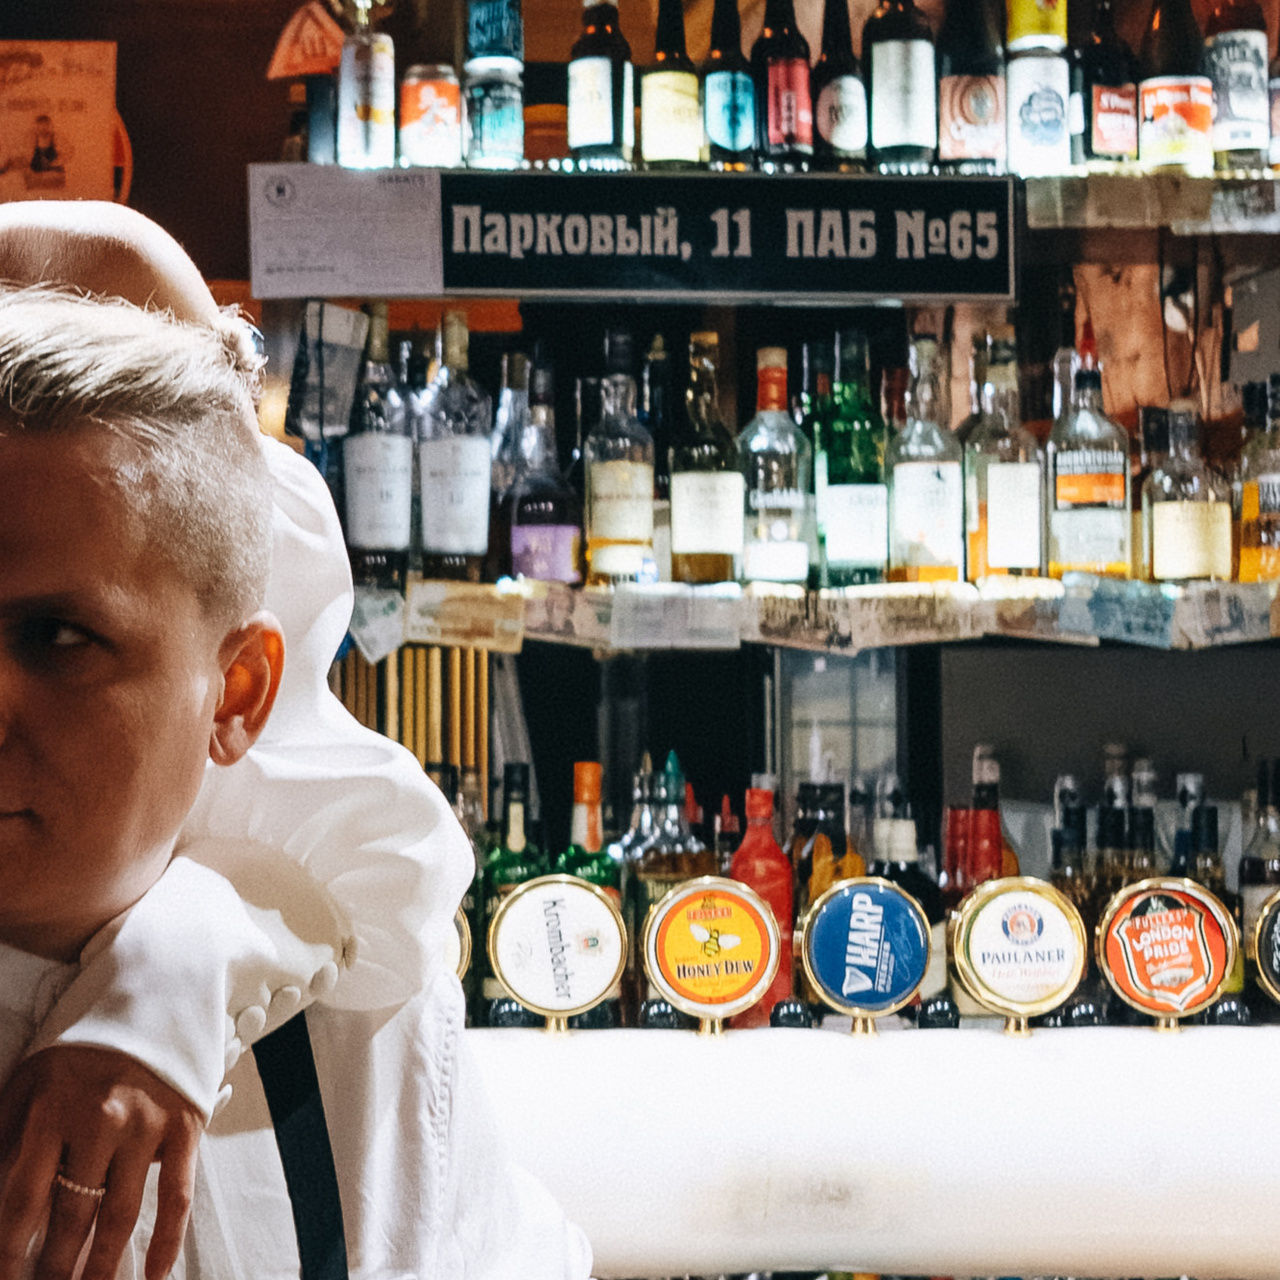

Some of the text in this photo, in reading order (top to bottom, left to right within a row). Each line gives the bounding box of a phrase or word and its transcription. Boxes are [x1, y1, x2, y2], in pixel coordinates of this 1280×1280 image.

[451, 202, 1000, 263] Парковый, 11 ПАБ №65
[844, 892, 884, 969] HARP
[1132, 924, 1194, 953] LONDON
[981, 949, 1065, 965] PAULANER
[1143, 939, 1188, 962] PRIDE
[676, 960, 721, 980] HONEY
[723, 959, 753, 976] DEW
